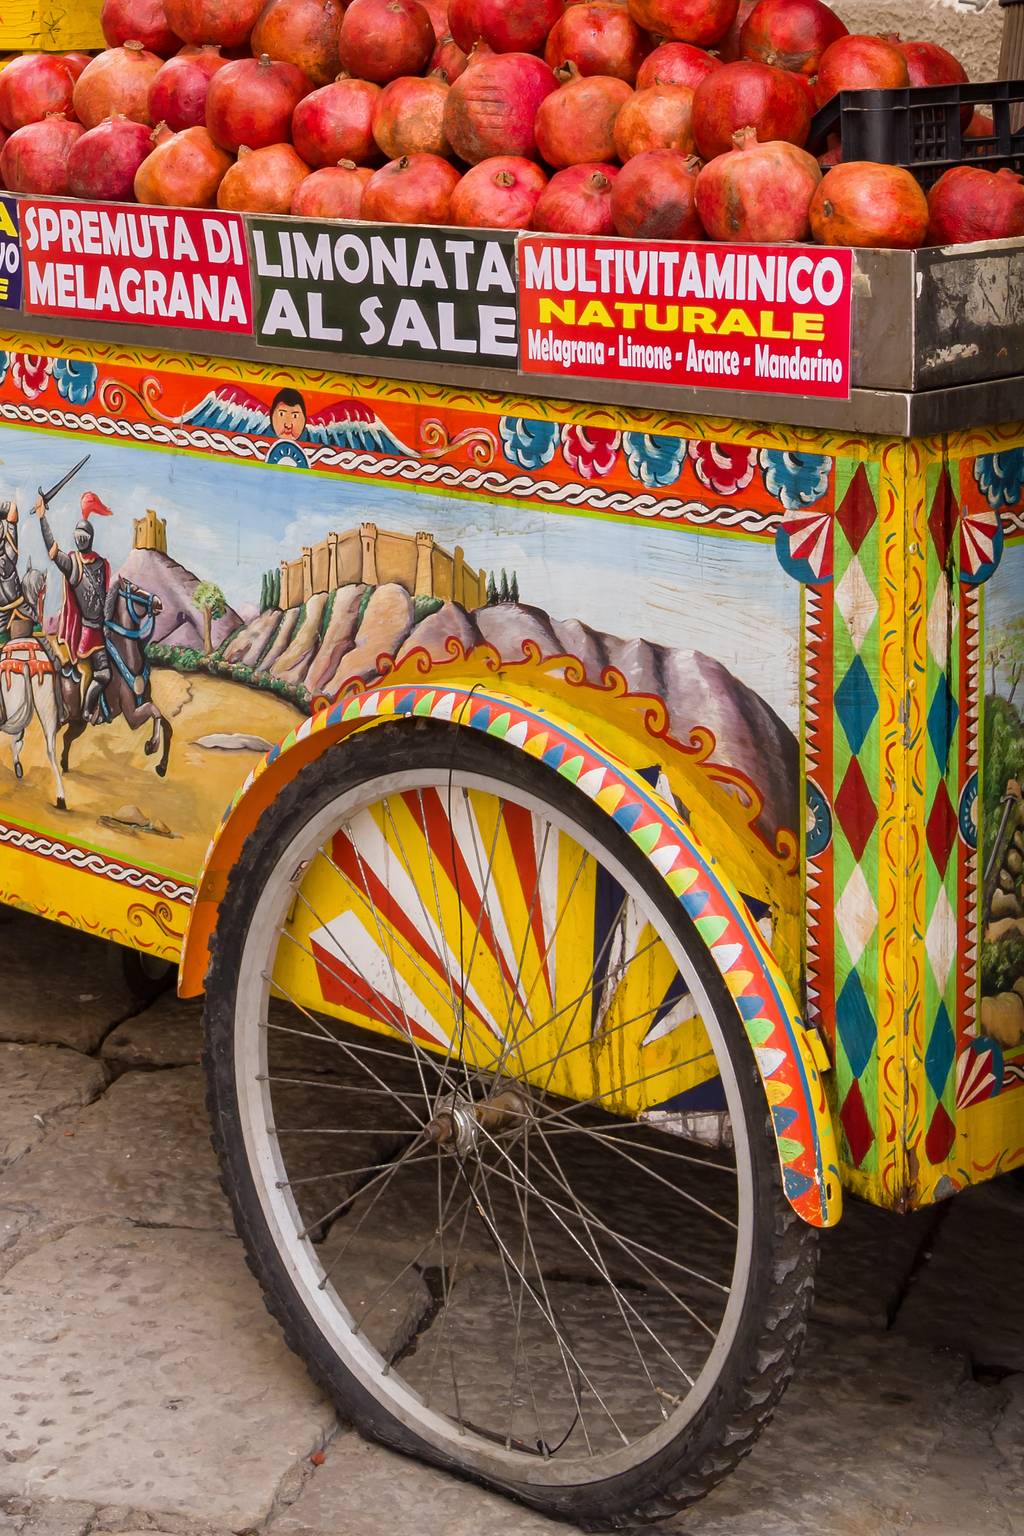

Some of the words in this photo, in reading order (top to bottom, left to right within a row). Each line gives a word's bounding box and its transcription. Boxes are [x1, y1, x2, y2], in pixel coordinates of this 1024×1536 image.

[25, 206, 199, 262] SPREMUTA
[202, 218, 244, 265] DI
[252, 230, 516, 294] LIMONATA
[28, 261, 248, 325] MELAGRANA
[524, 245, 844, 306] MULTIVITAMINICO
[261, 289, 343, 342] AL
[359, 296, 518, 357] SALE
[539, 298, 825, 342] NATURALE
[528, 329, 605, 365] Melagrana
[618, 335, 672, 370] Limone
[686, 339, 740, 376] Arance
[755, 344, 843, 384] Mandarino
